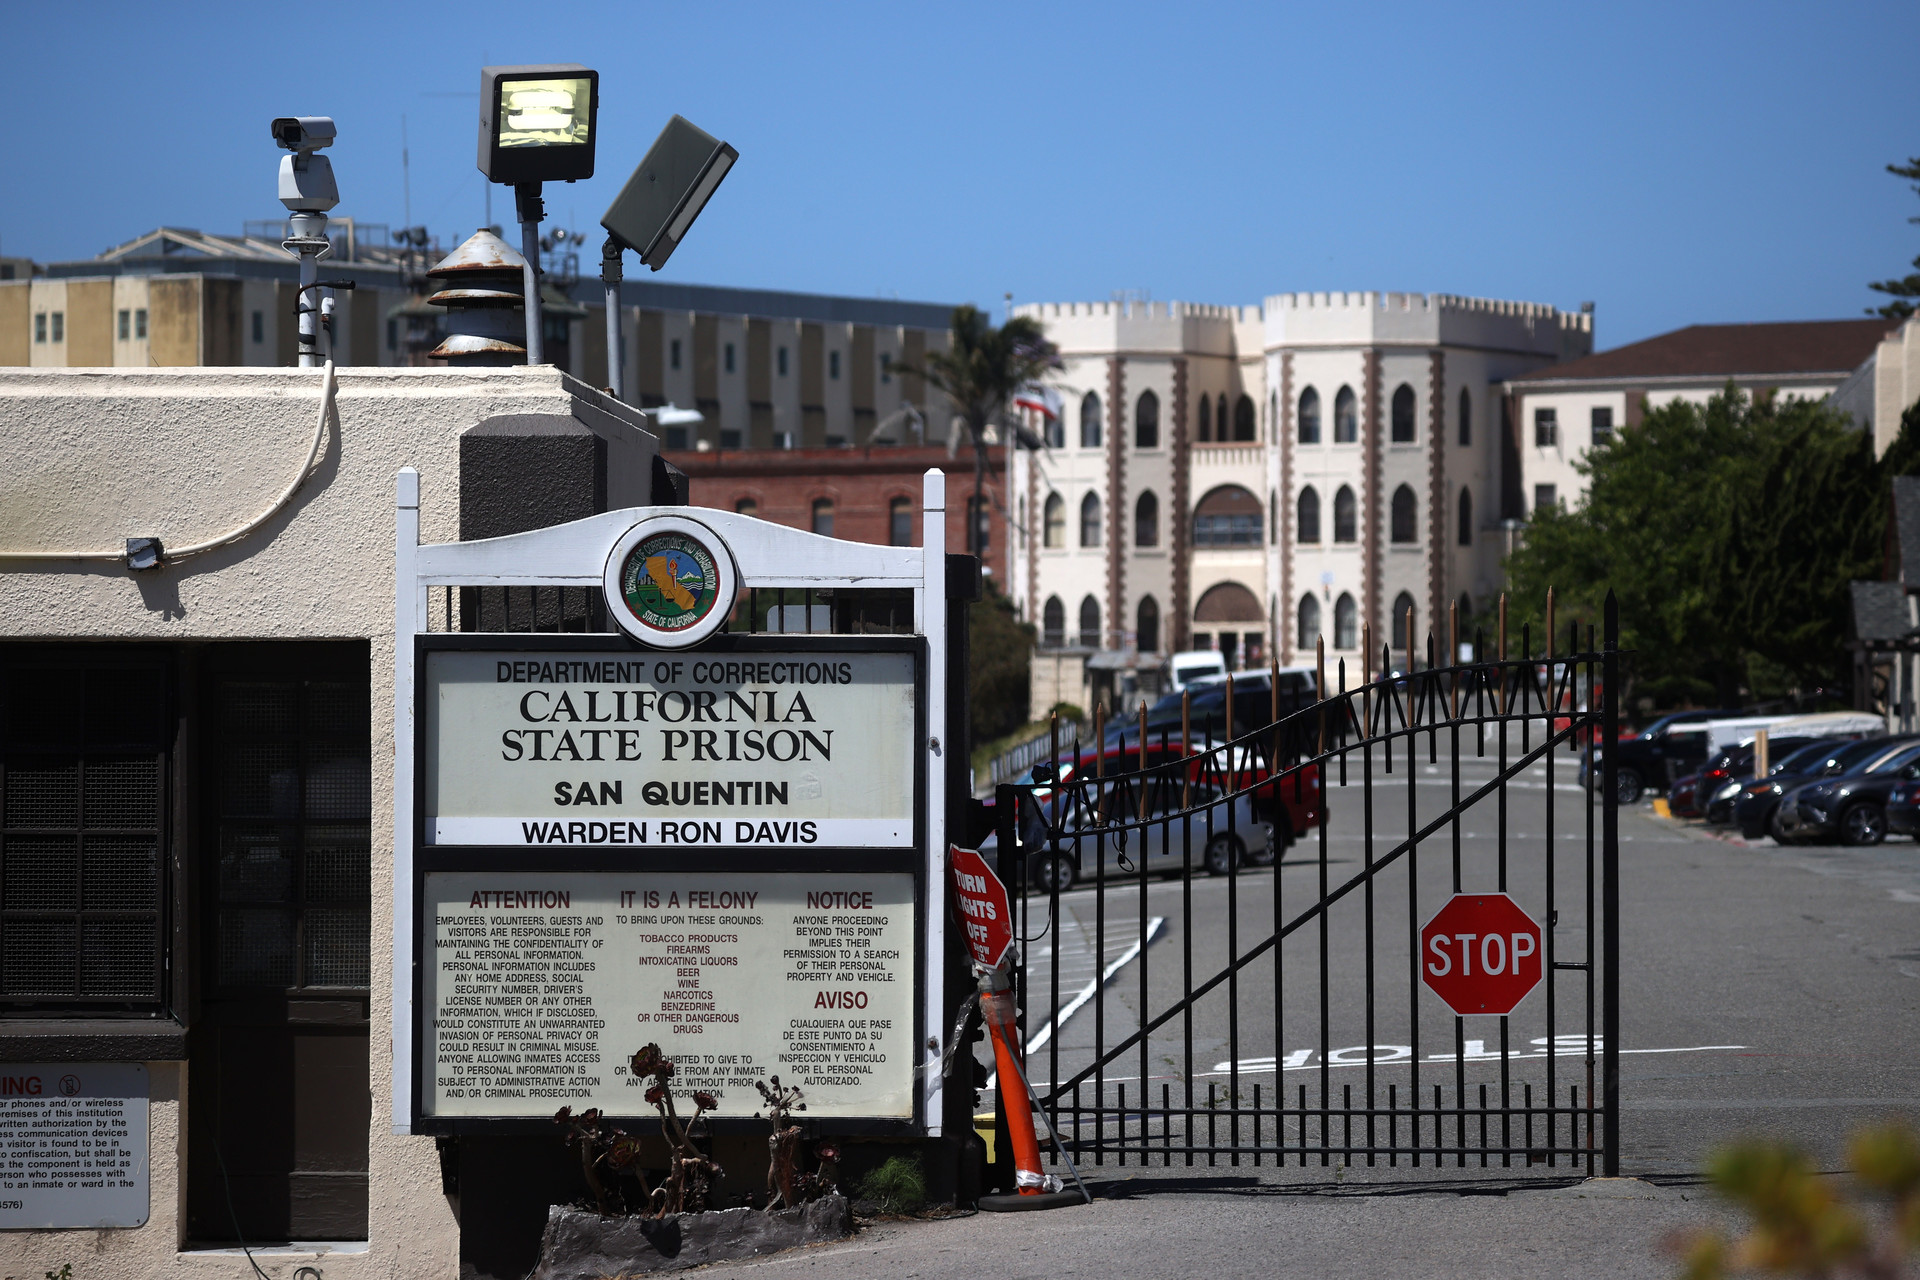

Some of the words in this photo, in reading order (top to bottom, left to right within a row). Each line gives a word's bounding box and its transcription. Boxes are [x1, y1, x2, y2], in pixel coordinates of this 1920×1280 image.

[642, 610, 659, 625] STATE
[659, 617, 666, 627] OF
[667, 612, 697, 628] CALIFORNIA
[497, 661, 645, 684] DEPARTMENT
[654, 662, 683, 684] OF
[693, 662, 852, 684] CORRECTIONS
[520, 689, 816, 722] CALIFORNIA
[502, 730, 641, 761] STATE
[660, 730, 834, 761] PRISON
[554, 780, 622, 806] SAN
[642, 781, 788, 806] QUENTIN
[522, 822, 646, 843] WARDEN
[660, 822, 721, 843] RON
[736, 822, 817, 843] DAVIS
[954, 868, 987, 894] TURN
[470, 891, 570, 909] ATTENTION
[621, 891, 635, 909] IT
[644, 891, 660, 909] IS
[667, 891, 680, 909] A
[688, 891, 759, 909] FELONY
[807, 891, 873, 909] NOTICE
[955, 891, 997, 920] LIGHTS
[436, 916, 487, 927] EMPLOYEES,
[490, 916, 546, 926] VOLUNTEERS,
[550, 916, 582, 925] GUESTS
[586, 917, 603, 925] AND
[616, 916, 627, 924] TO
[631, 916, 657, 924] BRING
[661, 916, 684, 924] UPON
[688, 916, 715, 924] THESE
[719, 916, 763, 925] GROUNDS:
[793, 916, 828, 925] ANYONE
[832, 916, 888, 925] PROCEEDING
[448, 928, 486, 936] VISITORS
[490, 928, 507, 936] ARE
[512, 928, 570, 936] RESPONSIBLE
[574, 928, 591, 937] FOR
[797, 927, 832, 936] BEYOND
[835, 928, 854, 936] THIS
[858, 928, 883, 936] POINT
[966, 920, 988, 943] OFF
[688, 934, 738, 942] PRODUCTS
[435, 938, 490, 948] MAINTAINING
[493, 940, 510, 948] THE
[514, 940, 588, 948] CONFIDENTIALITY
[592, 940, 603, 948] OF
[809, 939, 842, 947] IMPLIES
[846, 939, 870, 947] THEIR
[667, 945, 710, 954] FIREARMS
[455, 951, 471, 959] ALL
[474, 950, 520, 959] PERSONAL
[524, 951, 583, 959] INFORMATION.
[784, 950, 836, 958] PERMISSION
[840, 950, 850, 958] TO
[854, 950, 860, 958] A
[864, 950, 899, 959] SEARCH
[1428, 933, 1535, 977] STOP
[640, 957, 696, 965] INTOXICATING
[701, 957, 738, 966] LIQUORS
[797, 961, 808, 970] OF
[812, 961, 836, 970] THEIR
[840, 961, 885, 970] PERSONAL
[443, 962, 488, 971] PERSONAL
[492, 962, 550, 971] INFORMATION
[554, 962, 595, 971] INCLUDES
[677, 968, 699, 976] BEER
[787, 972, 832, 981] PROPERTY
[836, 973, 854, 981] AND
[858, 973, 895, 981] VEHICLE.
[455, 974, 472, 982] ANY
[476, 974, 501, 982] HOME
[505, 974, 548, 982] ADDRESS,
[552, 974, 583, 982] SOCIAL
[678, 980, 699, 988] WINE
[455, 985, 498, 994] SECURITY
[502, 985, 540, 994] NUMBER,
[544, 985, 583, 994] DRIVER'S
[664, 991, 713, 1000] NARCOTICS
[814, 991, 868, 1009] AVISO
[446, 996, 481, 1005] LICENSE
[486, 997, 522, 1005] NUMBER
[526, 997, 538, 1005] OR
[542, 997, 559, 1005] ANY
[563, 997, 591, 1005] OTHER
[662, 1002, 715, 1011] BENZEDRINE
[638, 1014, 650, 1022] OR
[654, 1014, 682, 1022] OTHER
[686, 1014, 739, 1023] DANGEROUS
[790, 1020, 844, 1028] CUALQUIERA
[848, 1020, 866, 1028] QUE
[870, 1020, 891, 1028] PASE
[674, 1025, 703, 1034] DRUGS
[783, 1031, 794, 1040] DE
[798, 1031, 819, 1040] ESTE
[824, 1031, 852, 1040] PUNTO
[856, 1032, 867, 1040] DA
[871, 1031, 882, 1040] SU
[790, 1042, 865, 1051] CONSENTIMIENTO
[869, 1043, 875, 1051] A
[703, 1055, 714, 1064] TO
[718, 1055, 737, 1064] GIVE
[741, 1055, 752, 1064] TO
[779, 1054, 830, 1062] INSPECCION
[835, 1054, 840, 1062] Y
[844, 1054, 886, 1062] VEHICULO
[614, 1067, 627, 1075] OR
[685, 1067, 709, 1075] FROM
[713, 1067, 730, 1075] ANY
[734, 1067, 765, 1075] INMATE
[792, 1065, 810, 1074] POR
[814, 1065, 824, 1074] EL
[828, 1065, 872, 1074] PERSONAL
[626, 1078, 643, 1086] ANY
[686, 1078, 724, 1086] WITHOUT
[728, 1078, 754, 1086] PRIOR
[804, 1076, 861, 1085] AUTORIZADO.
[0, 1076, 42, 1095] ING
[11, 1100, 45, 1109] phones
[50, 1098, 81, 1107] and/or
[85, 1098, 124, 1107] wireless
[0, 1109, 38, 1118] remises
[77, 1109, 122, 1117] institution
[32, 1119, 92, 1127] authorization
[96, 1119, 108, 1129] by
[111, 1119, 127, 1127] the
[18, 1129, 88, 1138] communication
[7, 1140, 36, 1148] visitor
[96, 1139, 107, 1147] be
[11, 1150, 70, 1158] confiscation,
[94, 1149, 115, 1157] shall
